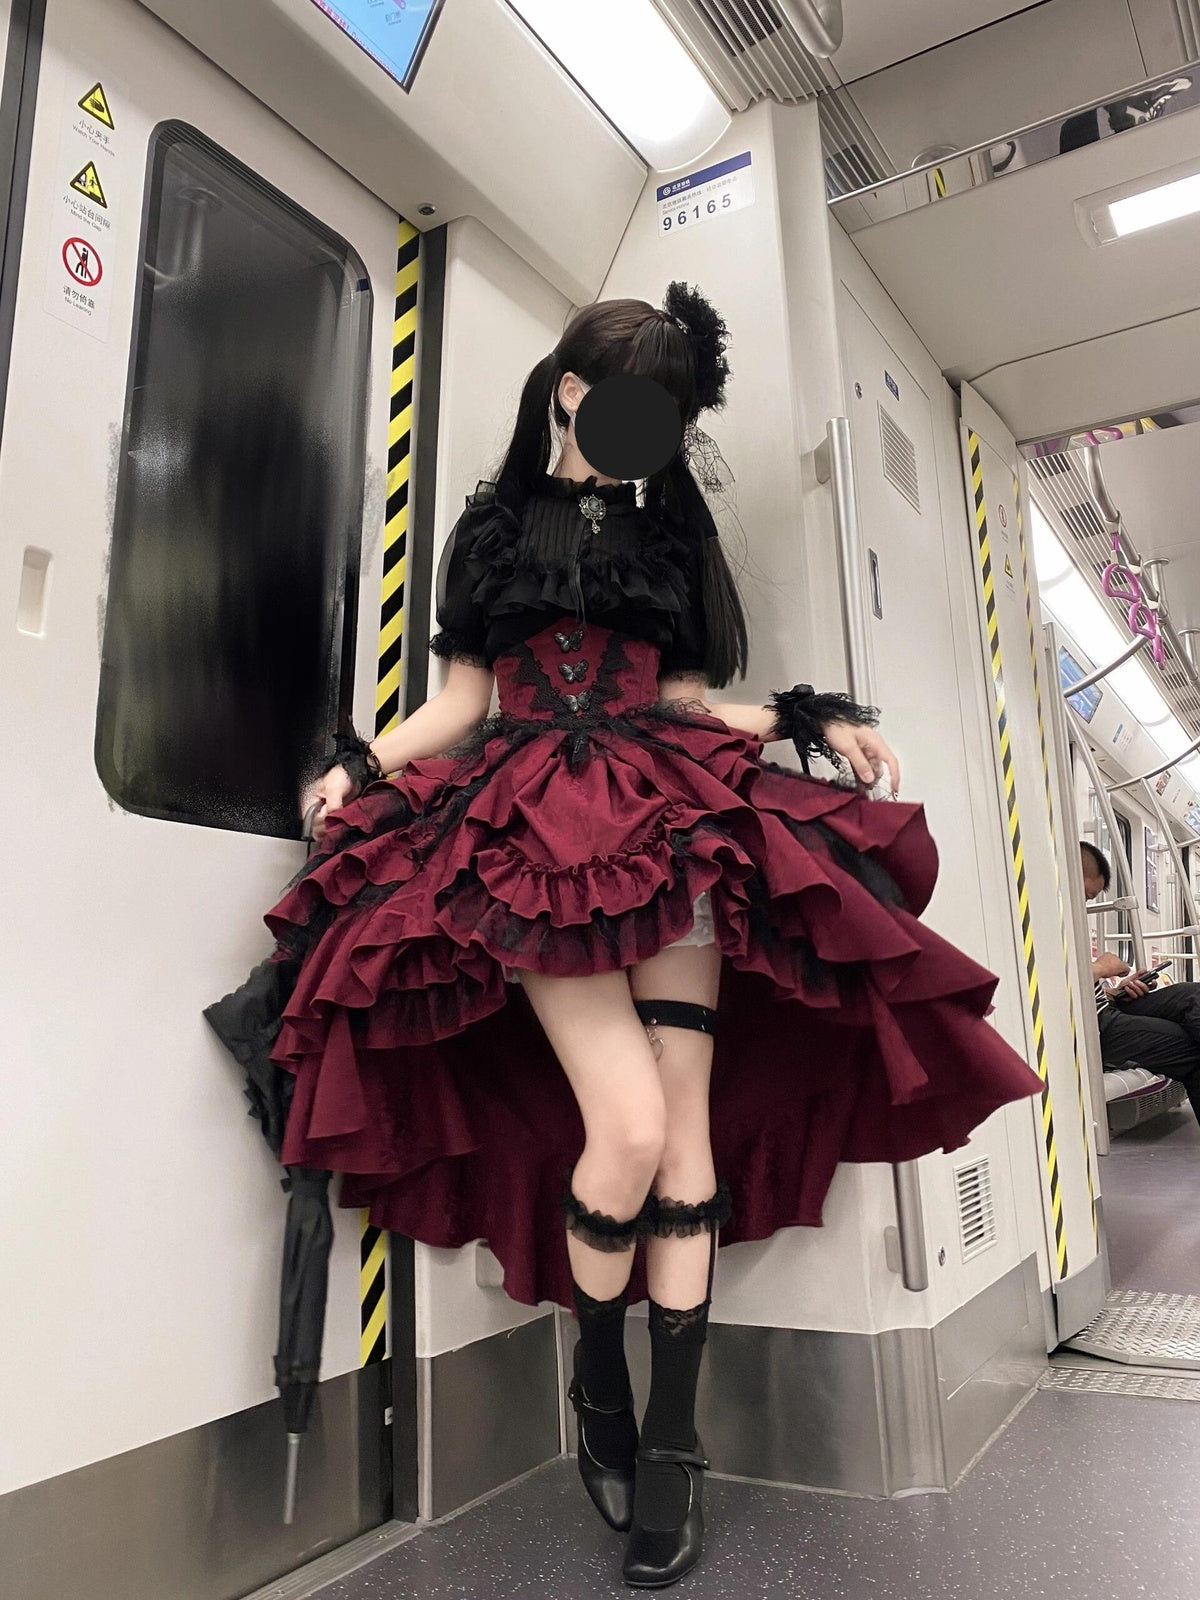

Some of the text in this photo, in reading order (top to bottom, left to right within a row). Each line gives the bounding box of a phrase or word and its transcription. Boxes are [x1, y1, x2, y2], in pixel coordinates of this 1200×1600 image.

[79, 120, 110, 144] 小心夹手
[63, 195, 111, 229] 小心站台间隙
[70, 209, 83, 220] Mind
[91, 222, 102, 232] Gap
[663, 193, 731, 231] 96165
[63, 285, 95, 309] 请勿倚靠
[64, 296, 72, 304] No
